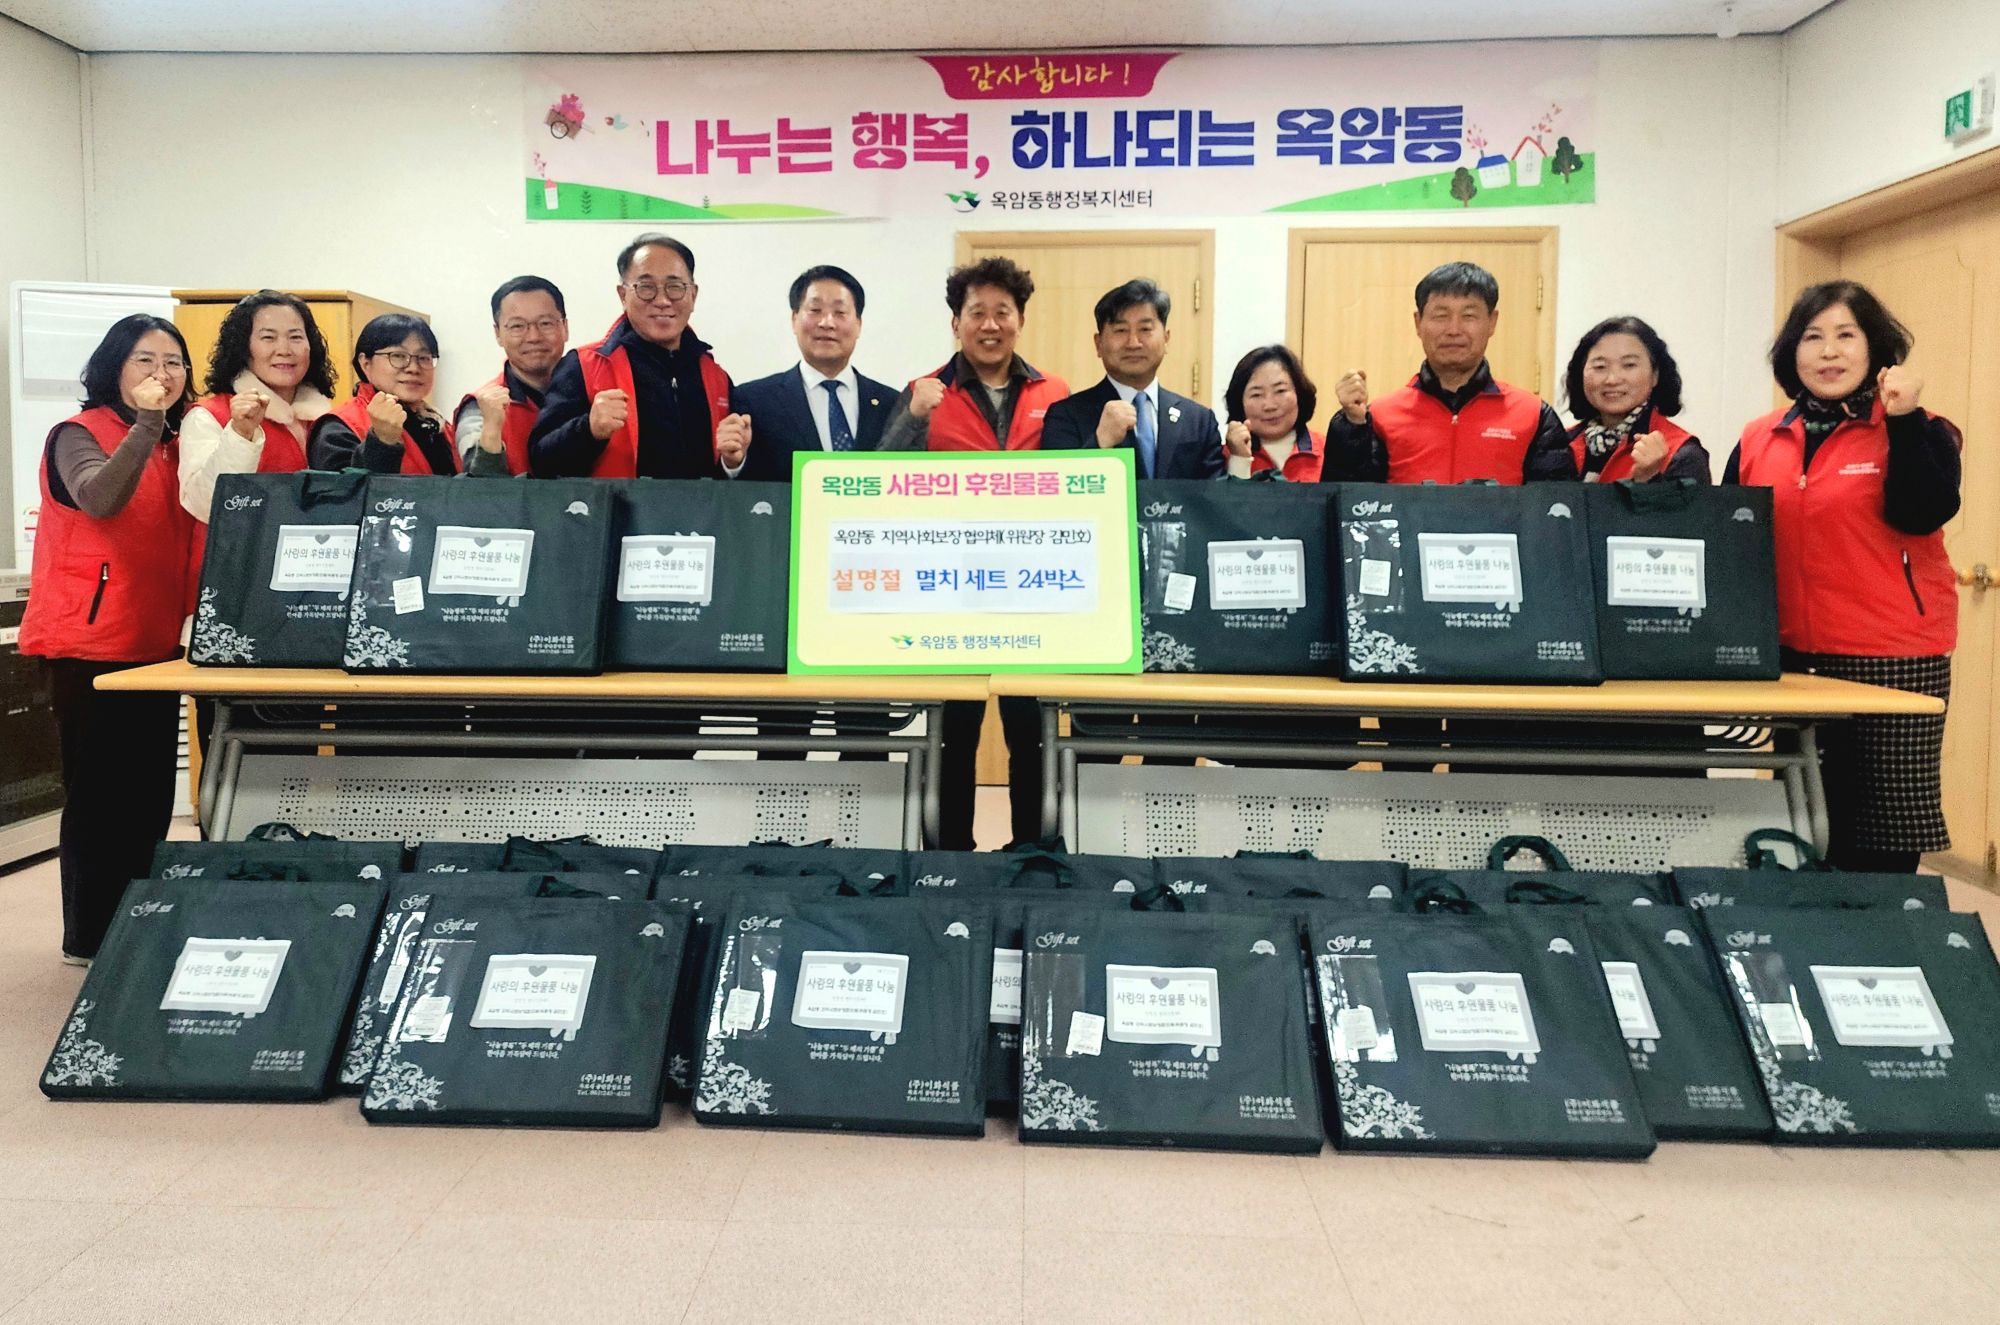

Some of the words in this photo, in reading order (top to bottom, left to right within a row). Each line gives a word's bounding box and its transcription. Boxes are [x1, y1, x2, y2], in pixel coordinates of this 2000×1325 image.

[968, 57, 1112, 94] 감사합니다
[656, 116, 832, 175] 나누는
[851, 111, 990, 180] 행복,
[1010, 108, 1255, 170] 하나되는
[1276, 105, 1464, 165] 옥암동
[990, 187, 1153, 209] 옥암동행정복지센터
[821, 475, 882, 497] 옥암동
[887, 472, 958, 497] 사랑의
[965, 471, 1060, 496] 후원물품
[1065, 473, 1107, 495] 전달
[834, 529, 876, 545] 옥암동
[832, 568, 901, 592] 설명절
[916, 568, 958, 592] 멸치
[965, 568, 1008, 592] 세트
[1018, 567, 1086, 592] 24박스
[919, 634, 960, 650] 옥암동
[962, 634, 1041, 650] 행정복지센터
